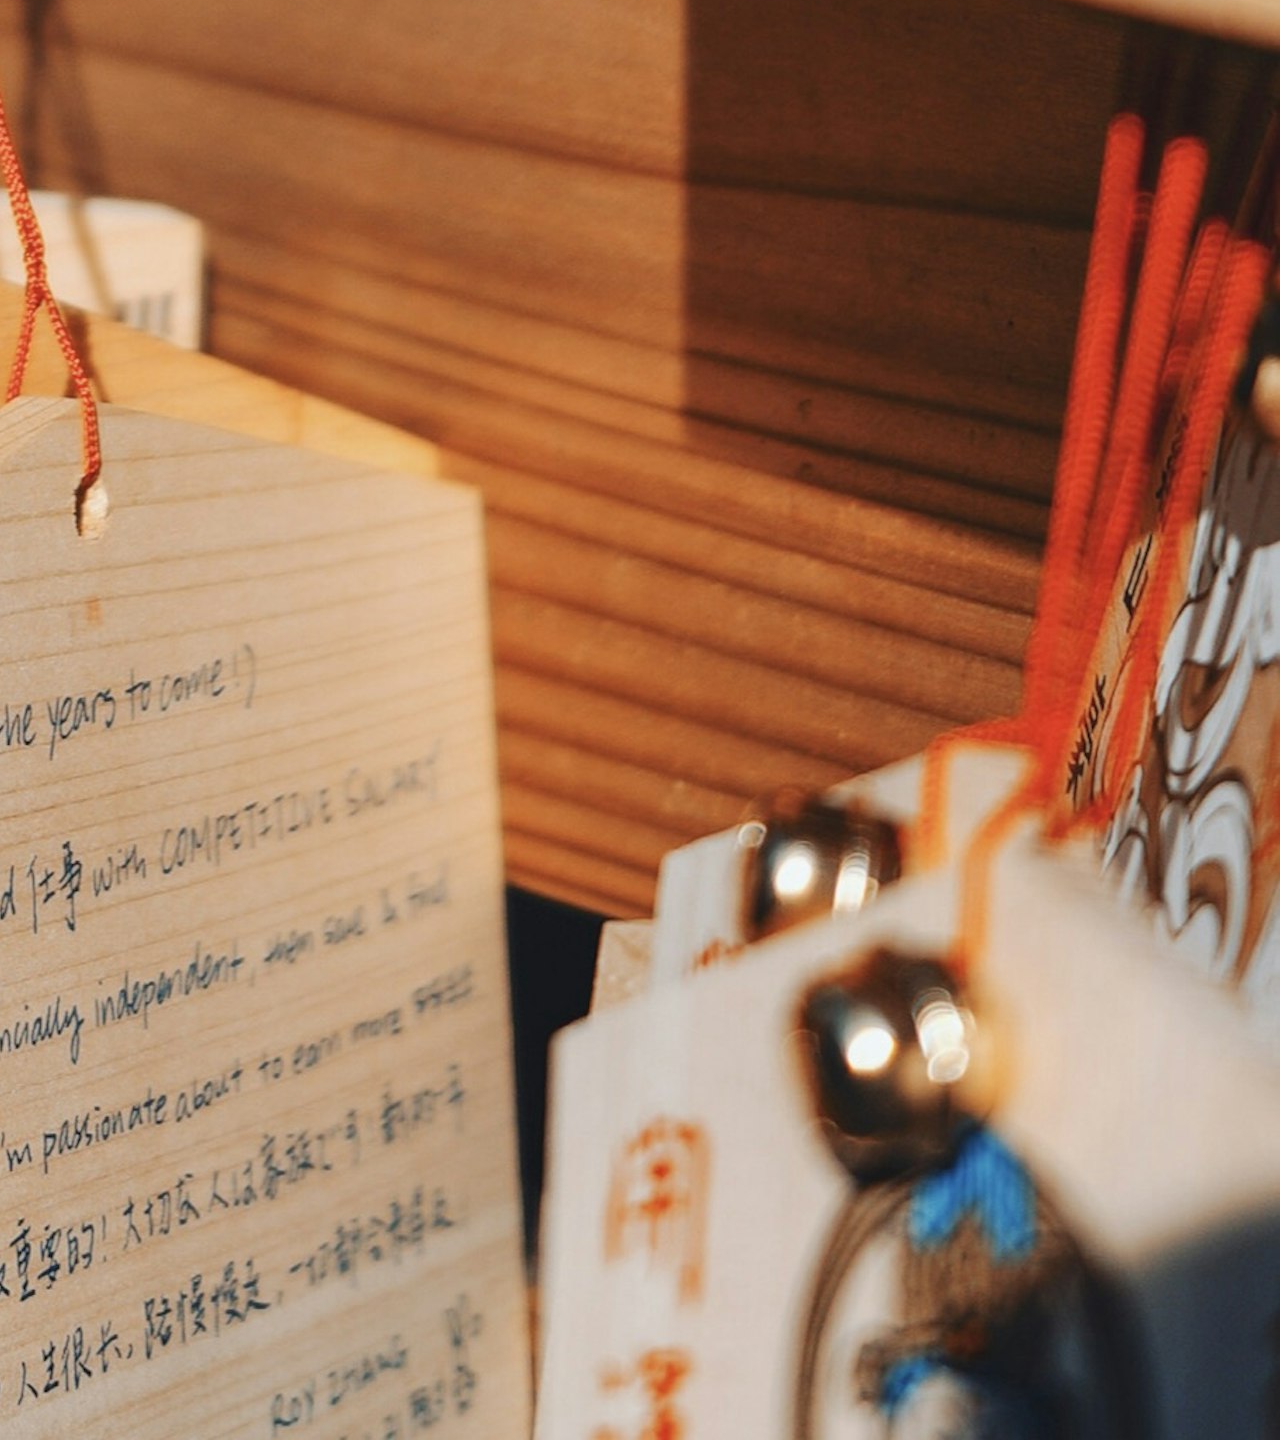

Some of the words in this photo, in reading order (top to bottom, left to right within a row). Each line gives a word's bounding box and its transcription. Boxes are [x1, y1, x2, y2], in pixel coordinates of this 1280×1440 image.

[47, 687, 117, 761] years
[124, 668, 151, 721] to
[92, 845, 148, 898] with
[42, 1091, 168, 1174] passionate
[175, 1067, 245, 1123] about
